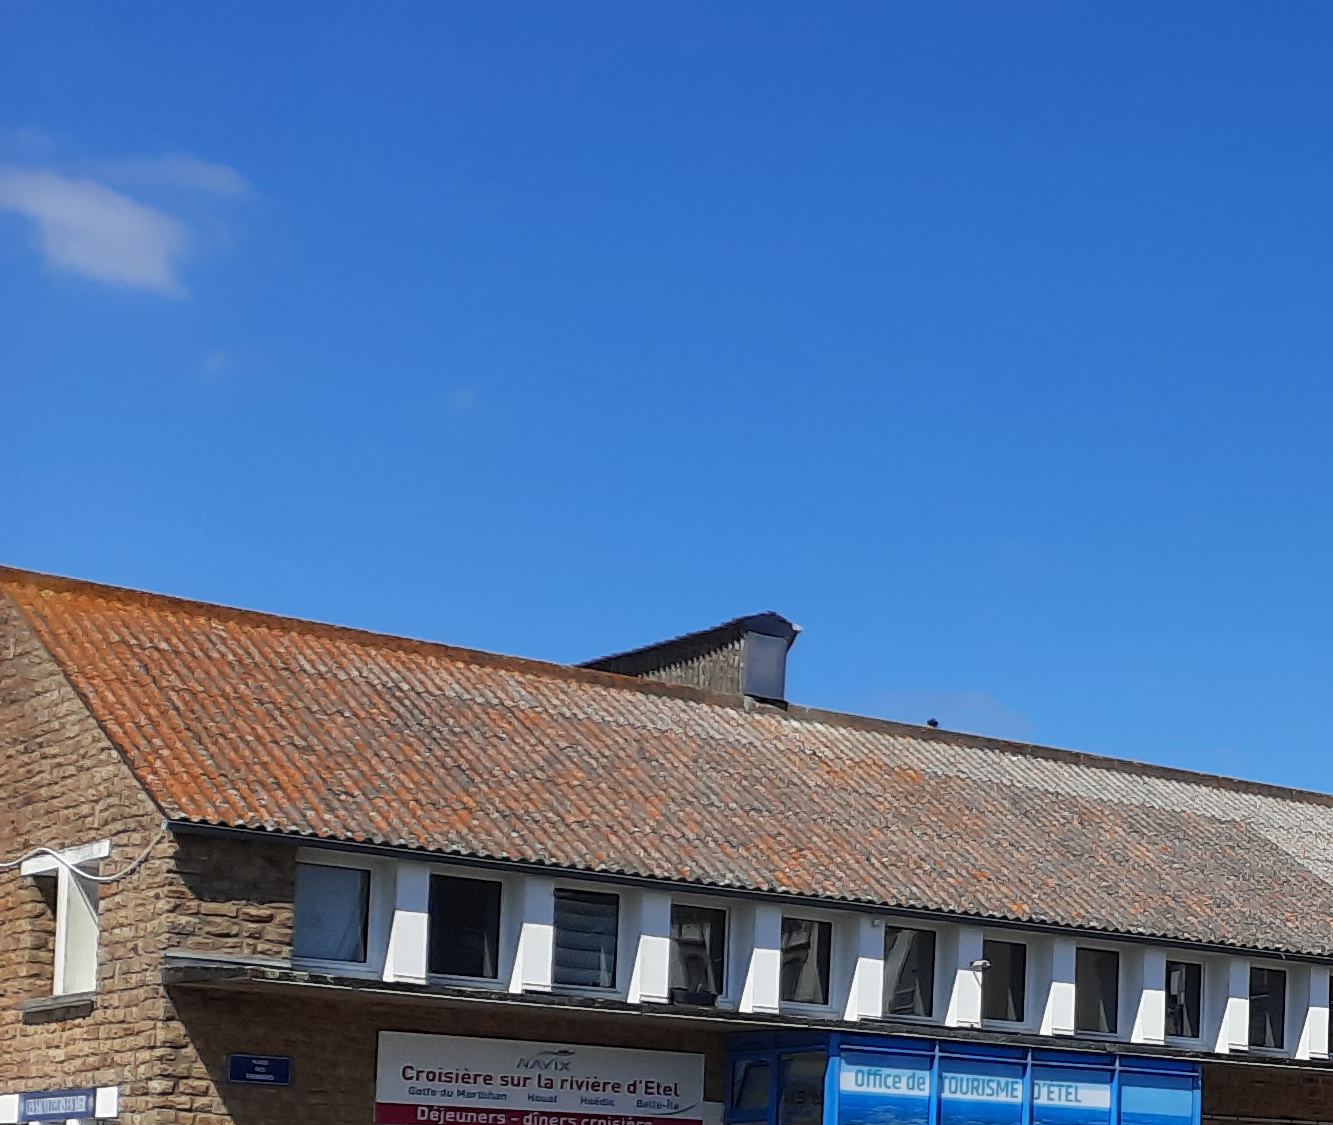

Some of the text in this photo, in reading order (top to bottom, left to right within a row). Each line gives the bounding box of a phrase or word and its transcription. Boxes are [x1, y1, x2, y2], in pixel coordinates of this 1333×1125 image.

[515, 1057, 571, 1071] NAVIX
[401, 1065, 680, 1098] Croisière sur la rivière d'Etel
[854, 1069, 900, 1089] Office
[906, 1069, 926, 1091] de
[941, 1075, 1019, 1099] TOURISME
[417, 1106, 506, 1125] Déjeuners
